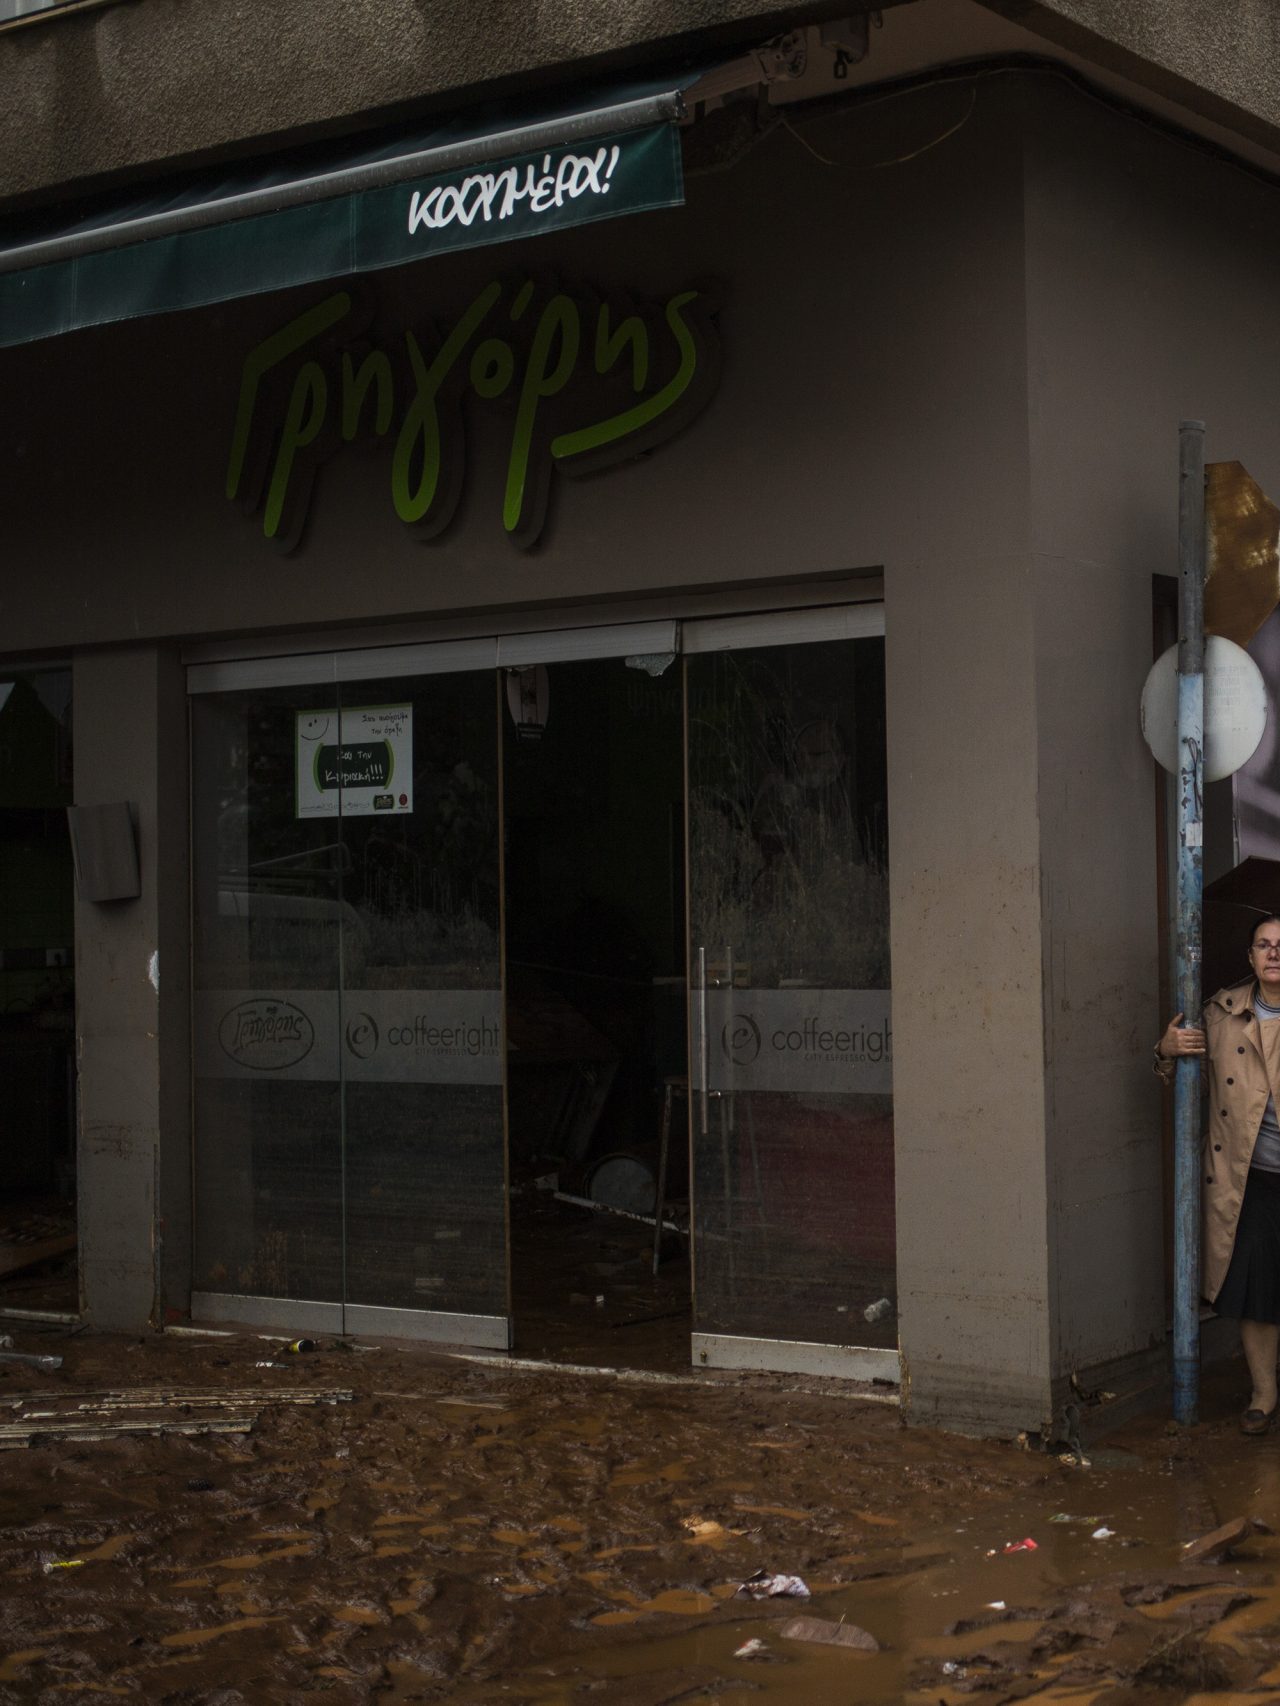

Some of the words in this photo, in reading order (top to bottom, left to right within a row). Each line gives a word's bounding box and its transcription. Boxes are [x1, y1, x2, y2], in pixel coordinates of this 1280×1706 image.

[226, 280, 698, 538] Γρηγόρης
[387, 1015, 500, 1056] coffeeright
[771, 1017, 893, 1062] coffeerigh
[825, 1053, 867, 1063] ESPRESSO
